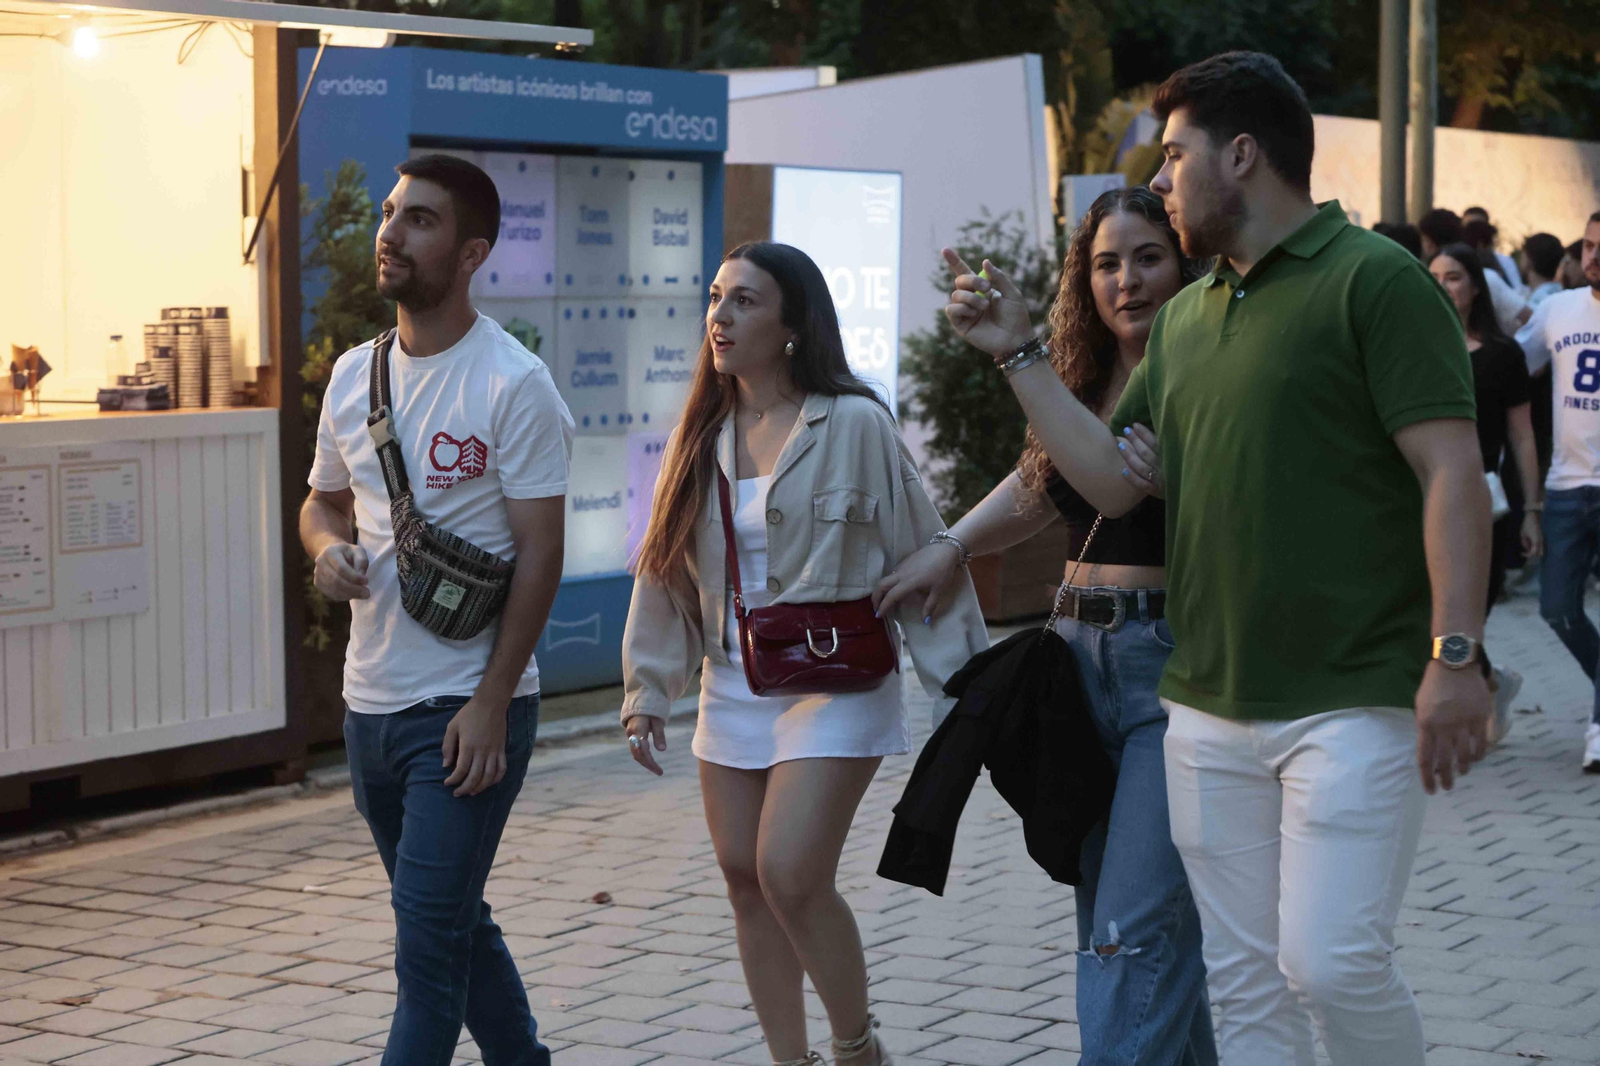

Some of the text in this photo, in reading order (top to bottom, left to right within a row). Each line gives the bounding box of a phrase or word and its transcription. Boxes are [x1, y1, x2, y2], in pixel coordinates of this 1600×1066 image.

[316, 76, 388, 96] endesa
[426, 68, 653, 106] Los artistas icónicos brillan con
[625, 107, 718, 142] endesa
[860, 266, 892, 310] TE
